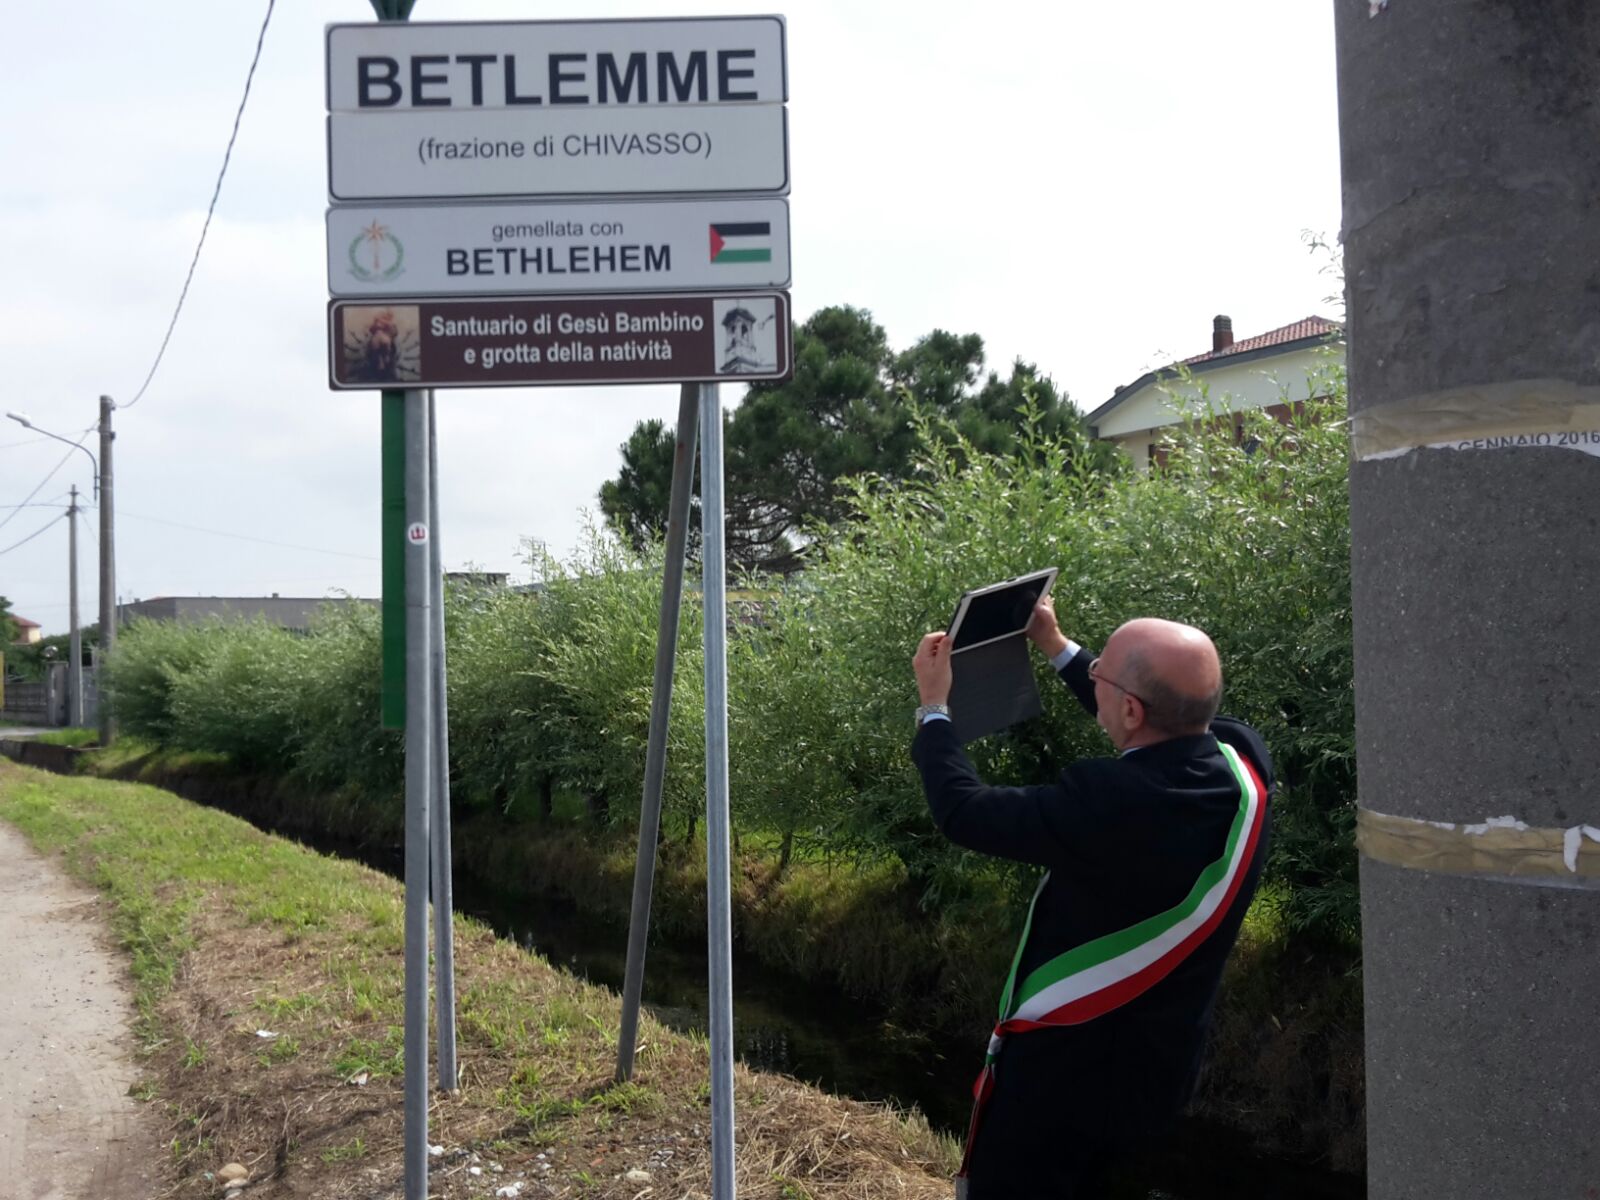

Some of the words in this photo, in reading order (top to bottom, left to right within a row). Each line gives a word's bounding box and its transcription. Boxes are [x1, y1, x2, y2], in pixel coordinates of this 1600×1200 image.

[356, 49, 758, 108] BETLEMME
[418, 137, 525, 164] (frazione
[533, 136, 554, 157] di
[563, 132, 712, 159] CHIVASSO)
[492, 220, 584, 242] gemellata
[590, 221, 624, 237] con
[446, 244, 671, 276] BETHLEHEM
[431, 314, 528, 337] Santuario
[533, 314, 551, 334] di
[557, 312, 609, 334] Gesù
[615, 311, 704, 333] Bambino
[464, 349, 476, 364] e
[481, 345, 541, 369] grotta
[547, 342, 594, 363] della
[600, 339, 673, 361] natività
[1558, 430, 1600, 446] 2016
